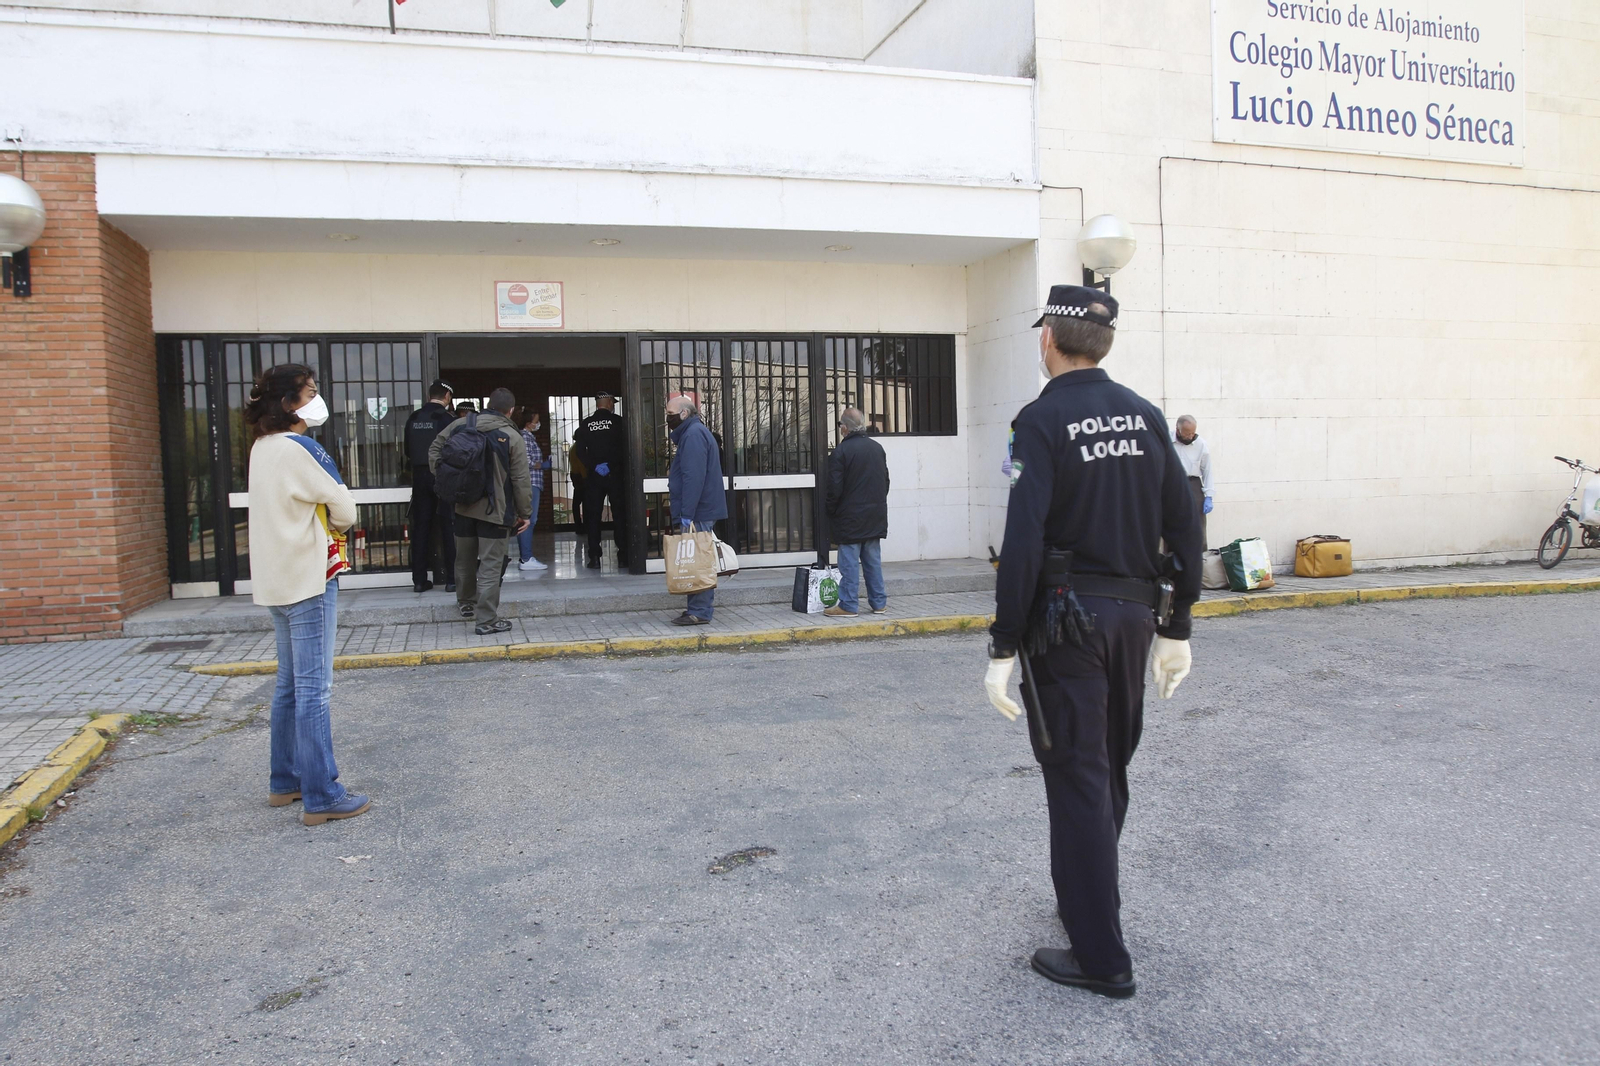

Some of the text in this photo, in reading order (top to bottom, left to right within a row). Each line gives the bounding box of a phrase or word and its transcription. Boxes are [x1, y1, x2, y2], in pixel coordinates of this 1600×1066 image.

[1267, 0, 1480, 43] Servicio de Alojamiento
[1229, 30, 1516, 93] Colegio Mayor Universitario
[1229, 80, 1515, 147] Lucio Anneo Séneca
[1080, 440, 1144, 462] LOCAL
